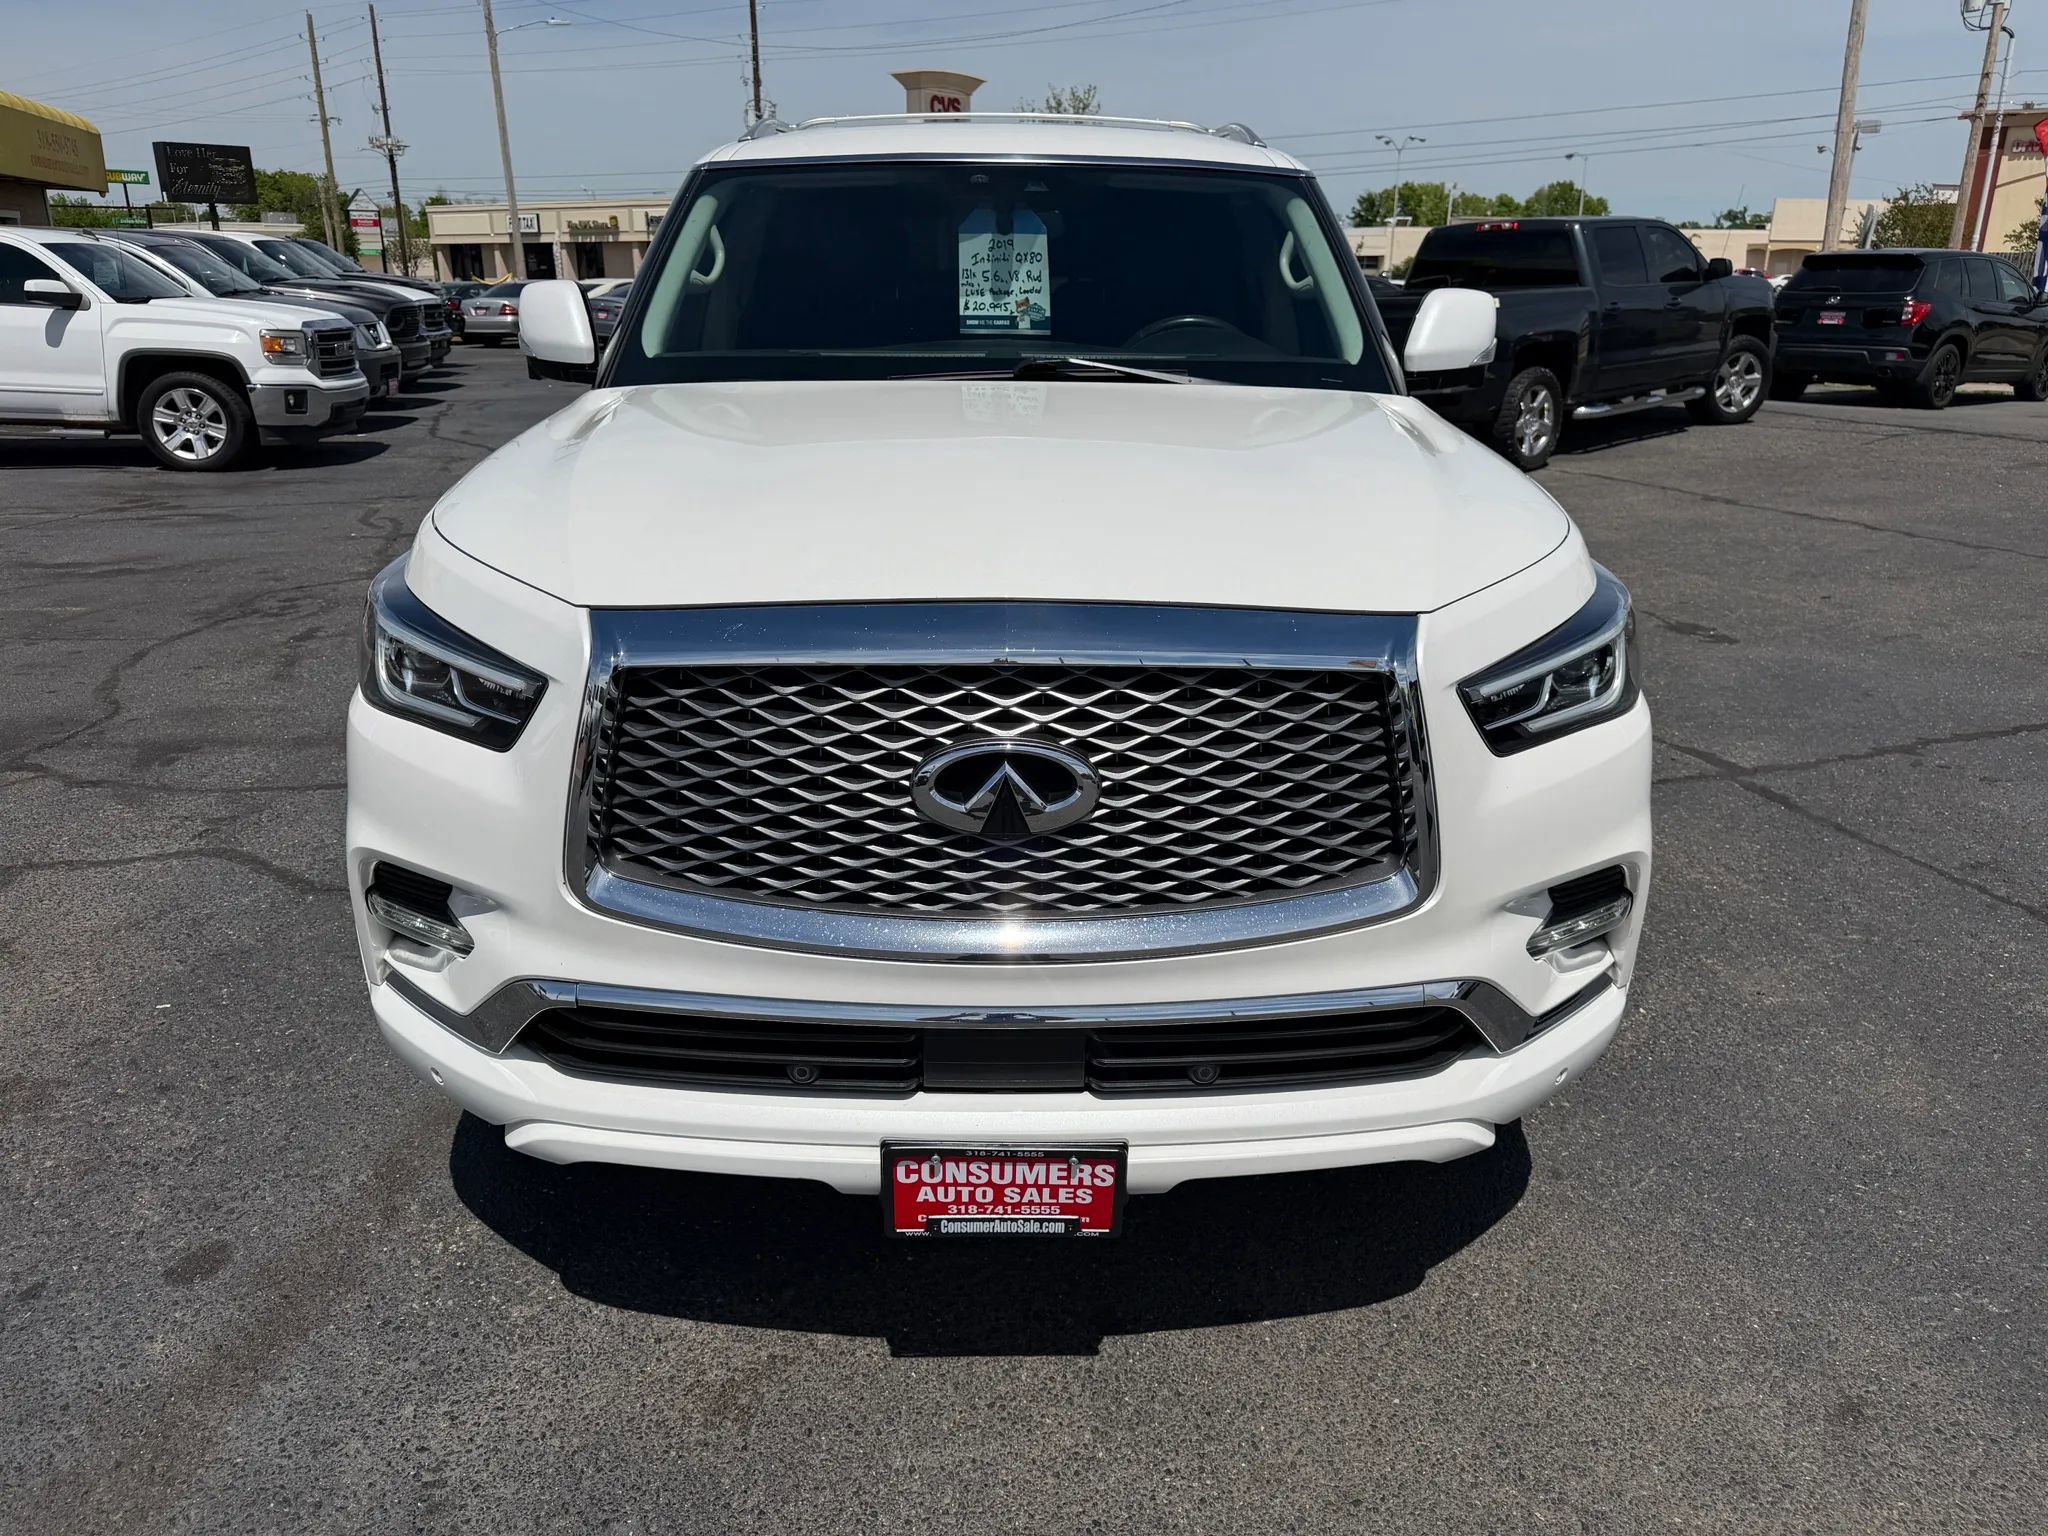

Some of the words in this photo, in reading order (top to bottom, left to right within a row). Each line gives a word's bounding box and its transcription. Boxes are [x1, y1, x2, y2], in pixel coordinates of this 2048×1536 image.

[930, 94, 962, 112] CVS
[166, 145, 193, 157] Love
[196, 147, 216, 158] Her
[169, 163, 189, 175] For
[171, 178, 221, 201] Eternity
[987, 239, 1015, 252] 2019
[971, 252, 1010, 266] Infiniti
[1015, 252, 1043, 264] QX80
[965, 1150, 1045, 1158] 318-741-5555
[896, 1160, 1115, 1187] CONSUMERS
[916, 1186, 994, 1204] AUTO
[1003, 1187, 1093, 1205] SALES
[947, 1204, 1061, 1215] 318-741-5555
[940, 1219, 1065, 1234] ConsumerAutoSale.com
